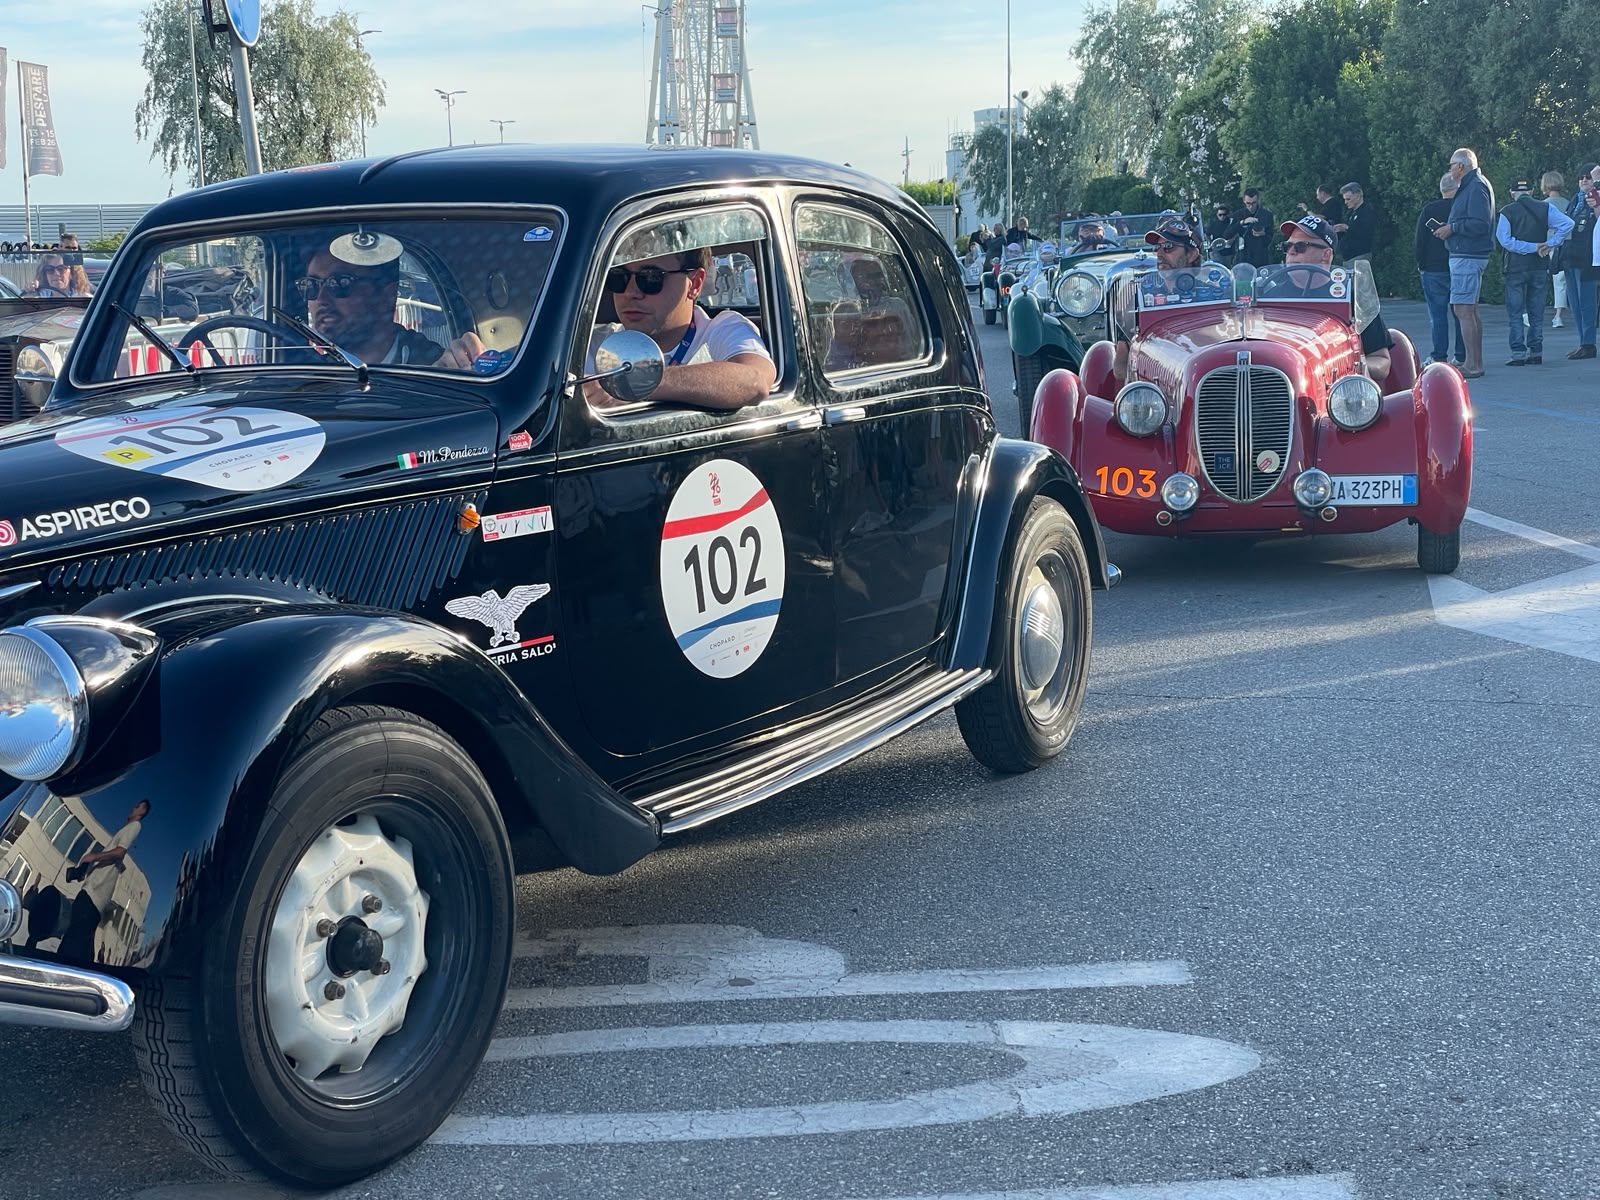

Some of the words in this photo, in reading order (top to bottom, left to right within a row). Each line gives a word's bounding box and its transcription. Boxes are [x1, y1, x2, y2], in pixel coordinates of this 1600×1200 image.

[31, 68, 48, 126] PESCARE
[30, 138, 46, 146] FEB
[46, 130, 55, 138] 15
[108, 415, 282, 455] 102
[118, 452, 134, 460] P
[209, 453, 253, 468] CHOPARD
[1096, 466, 1157, 498] 103
[1351, 480, 1402, 500] 323PH
[21, 497, 151, 541] ASPIRECO
[684, 525, 767, 614] 102
[710, 635, 736, 650] CHOPARD
